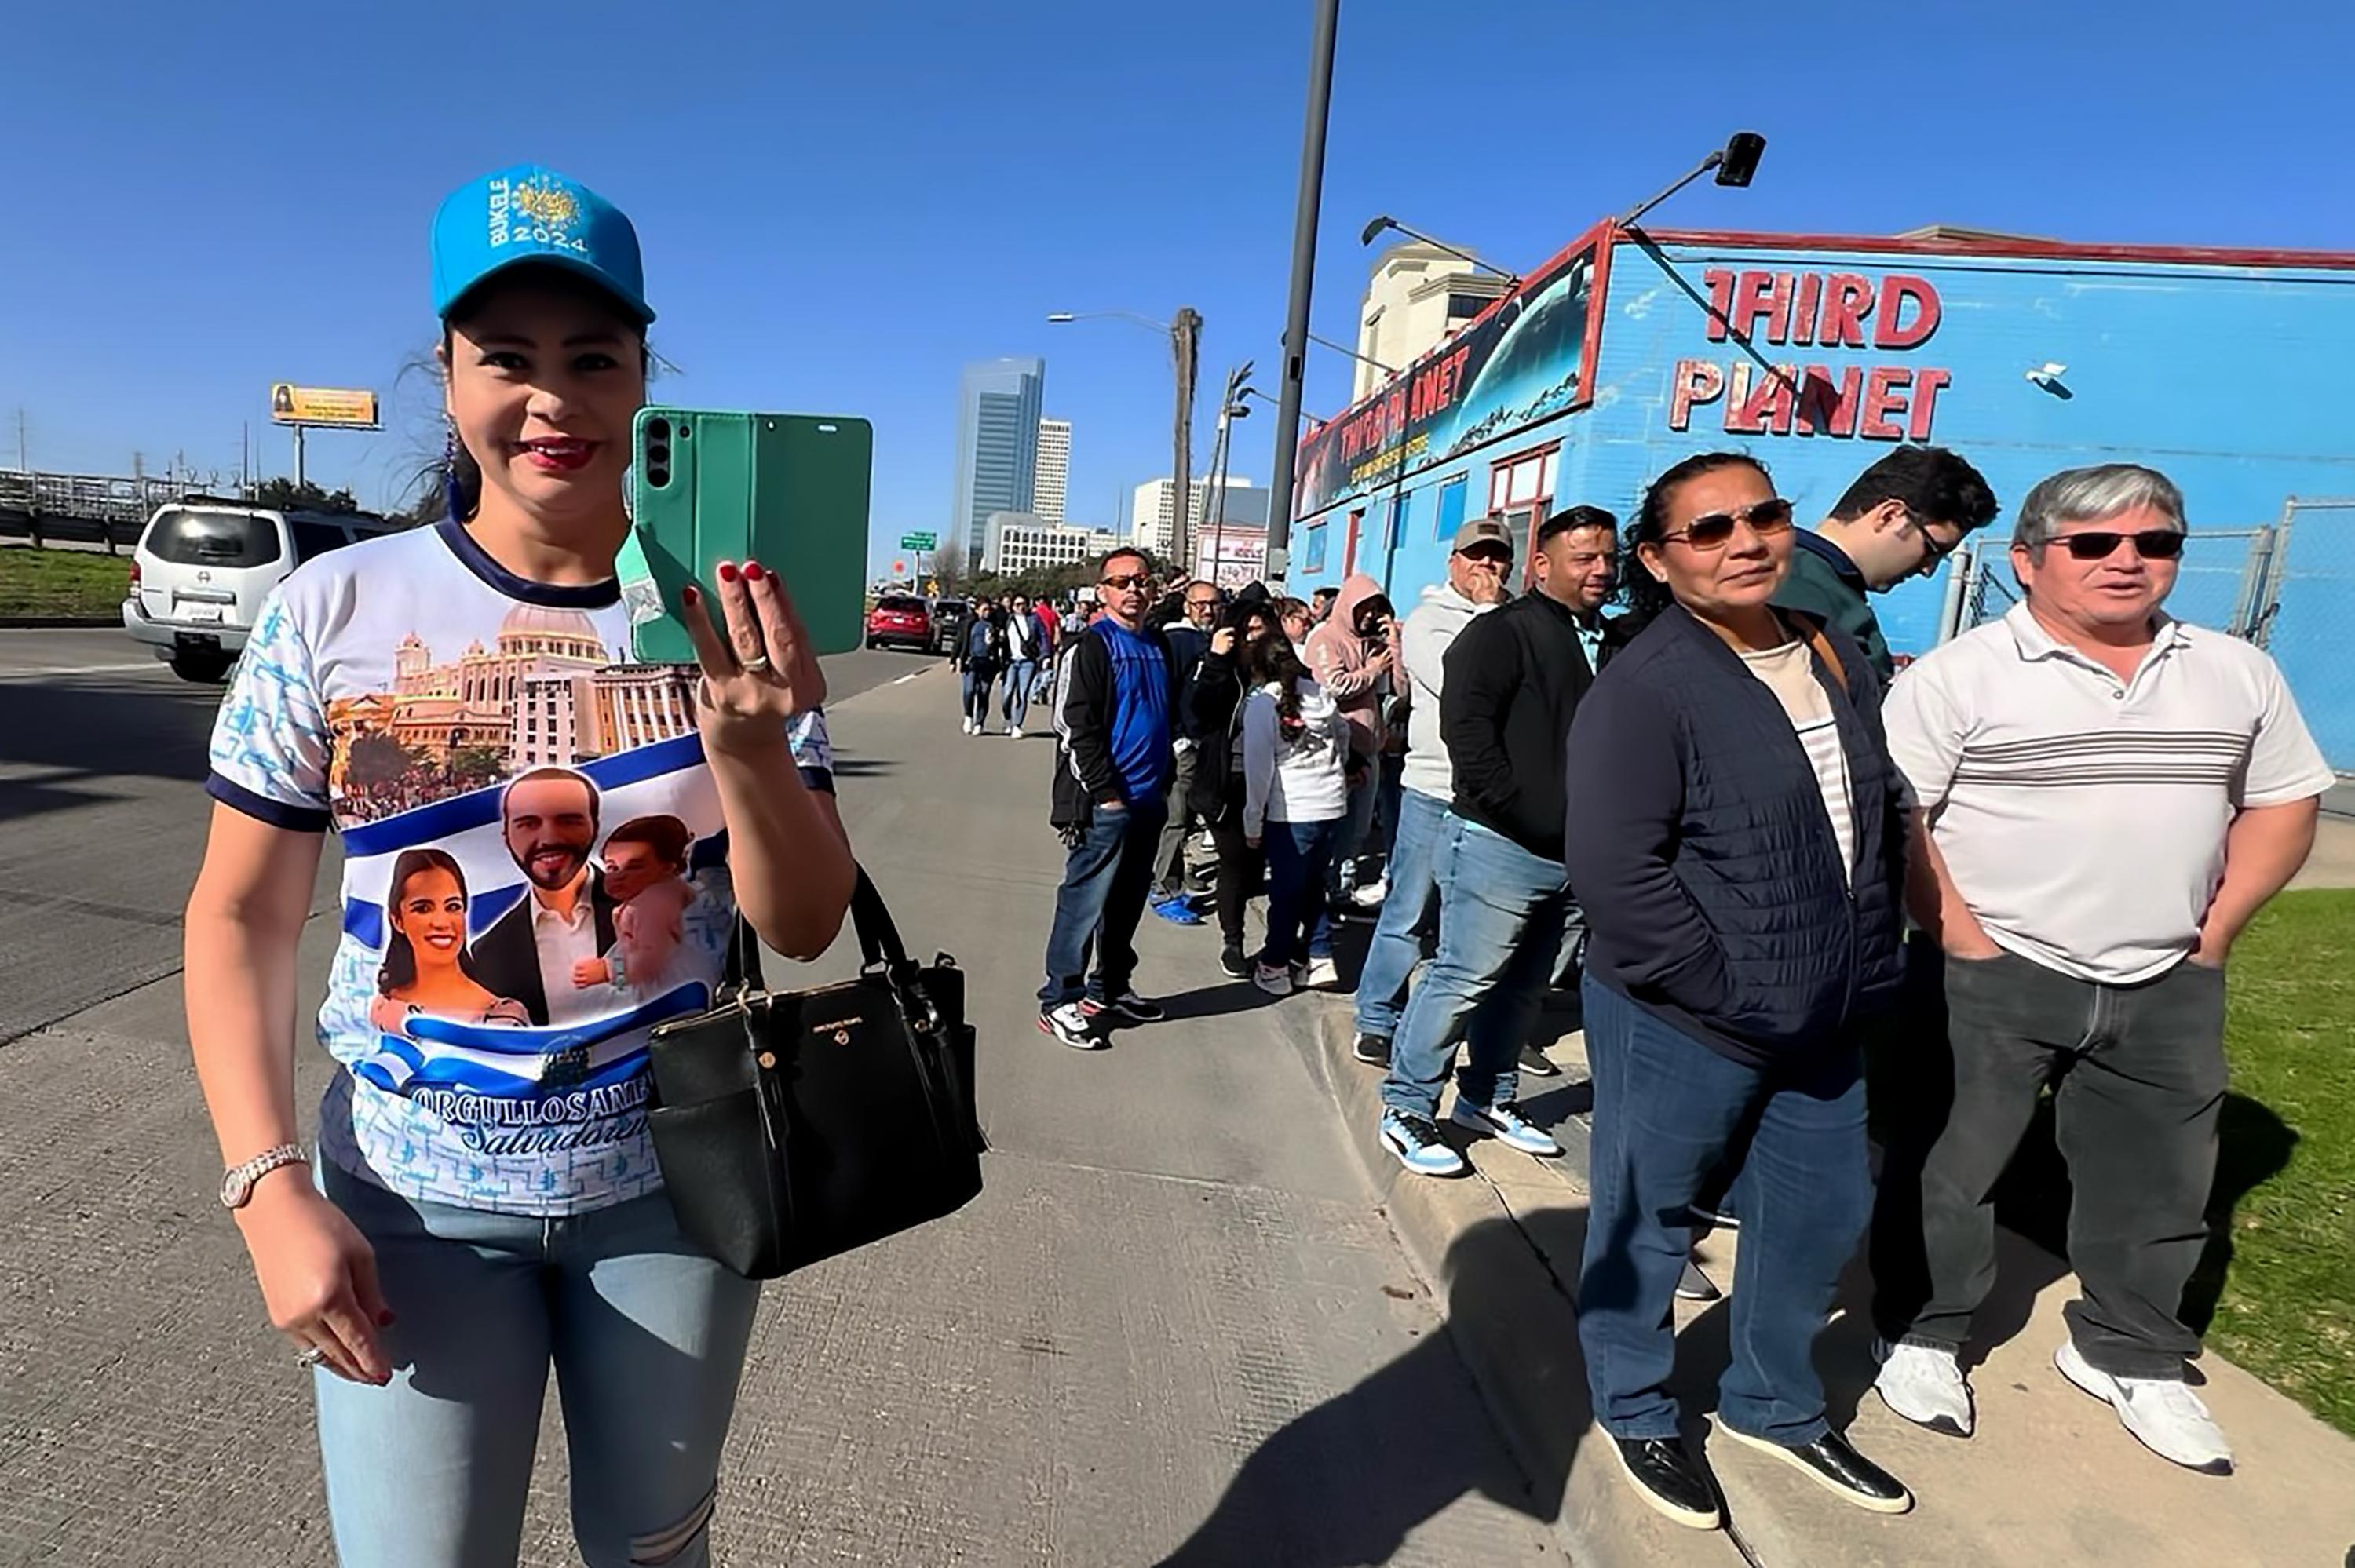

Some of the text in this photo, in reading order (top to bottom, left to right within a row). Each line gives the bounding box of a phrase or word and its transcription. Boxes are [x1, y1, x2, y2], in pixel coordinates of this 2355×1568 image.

[489, 177, 509, 248] BUKELE
[513, 226, 588, 252] 2024
[1704, 268, 1941, 348] THIRD
[1669, 360, 1952, 443] PLANET
